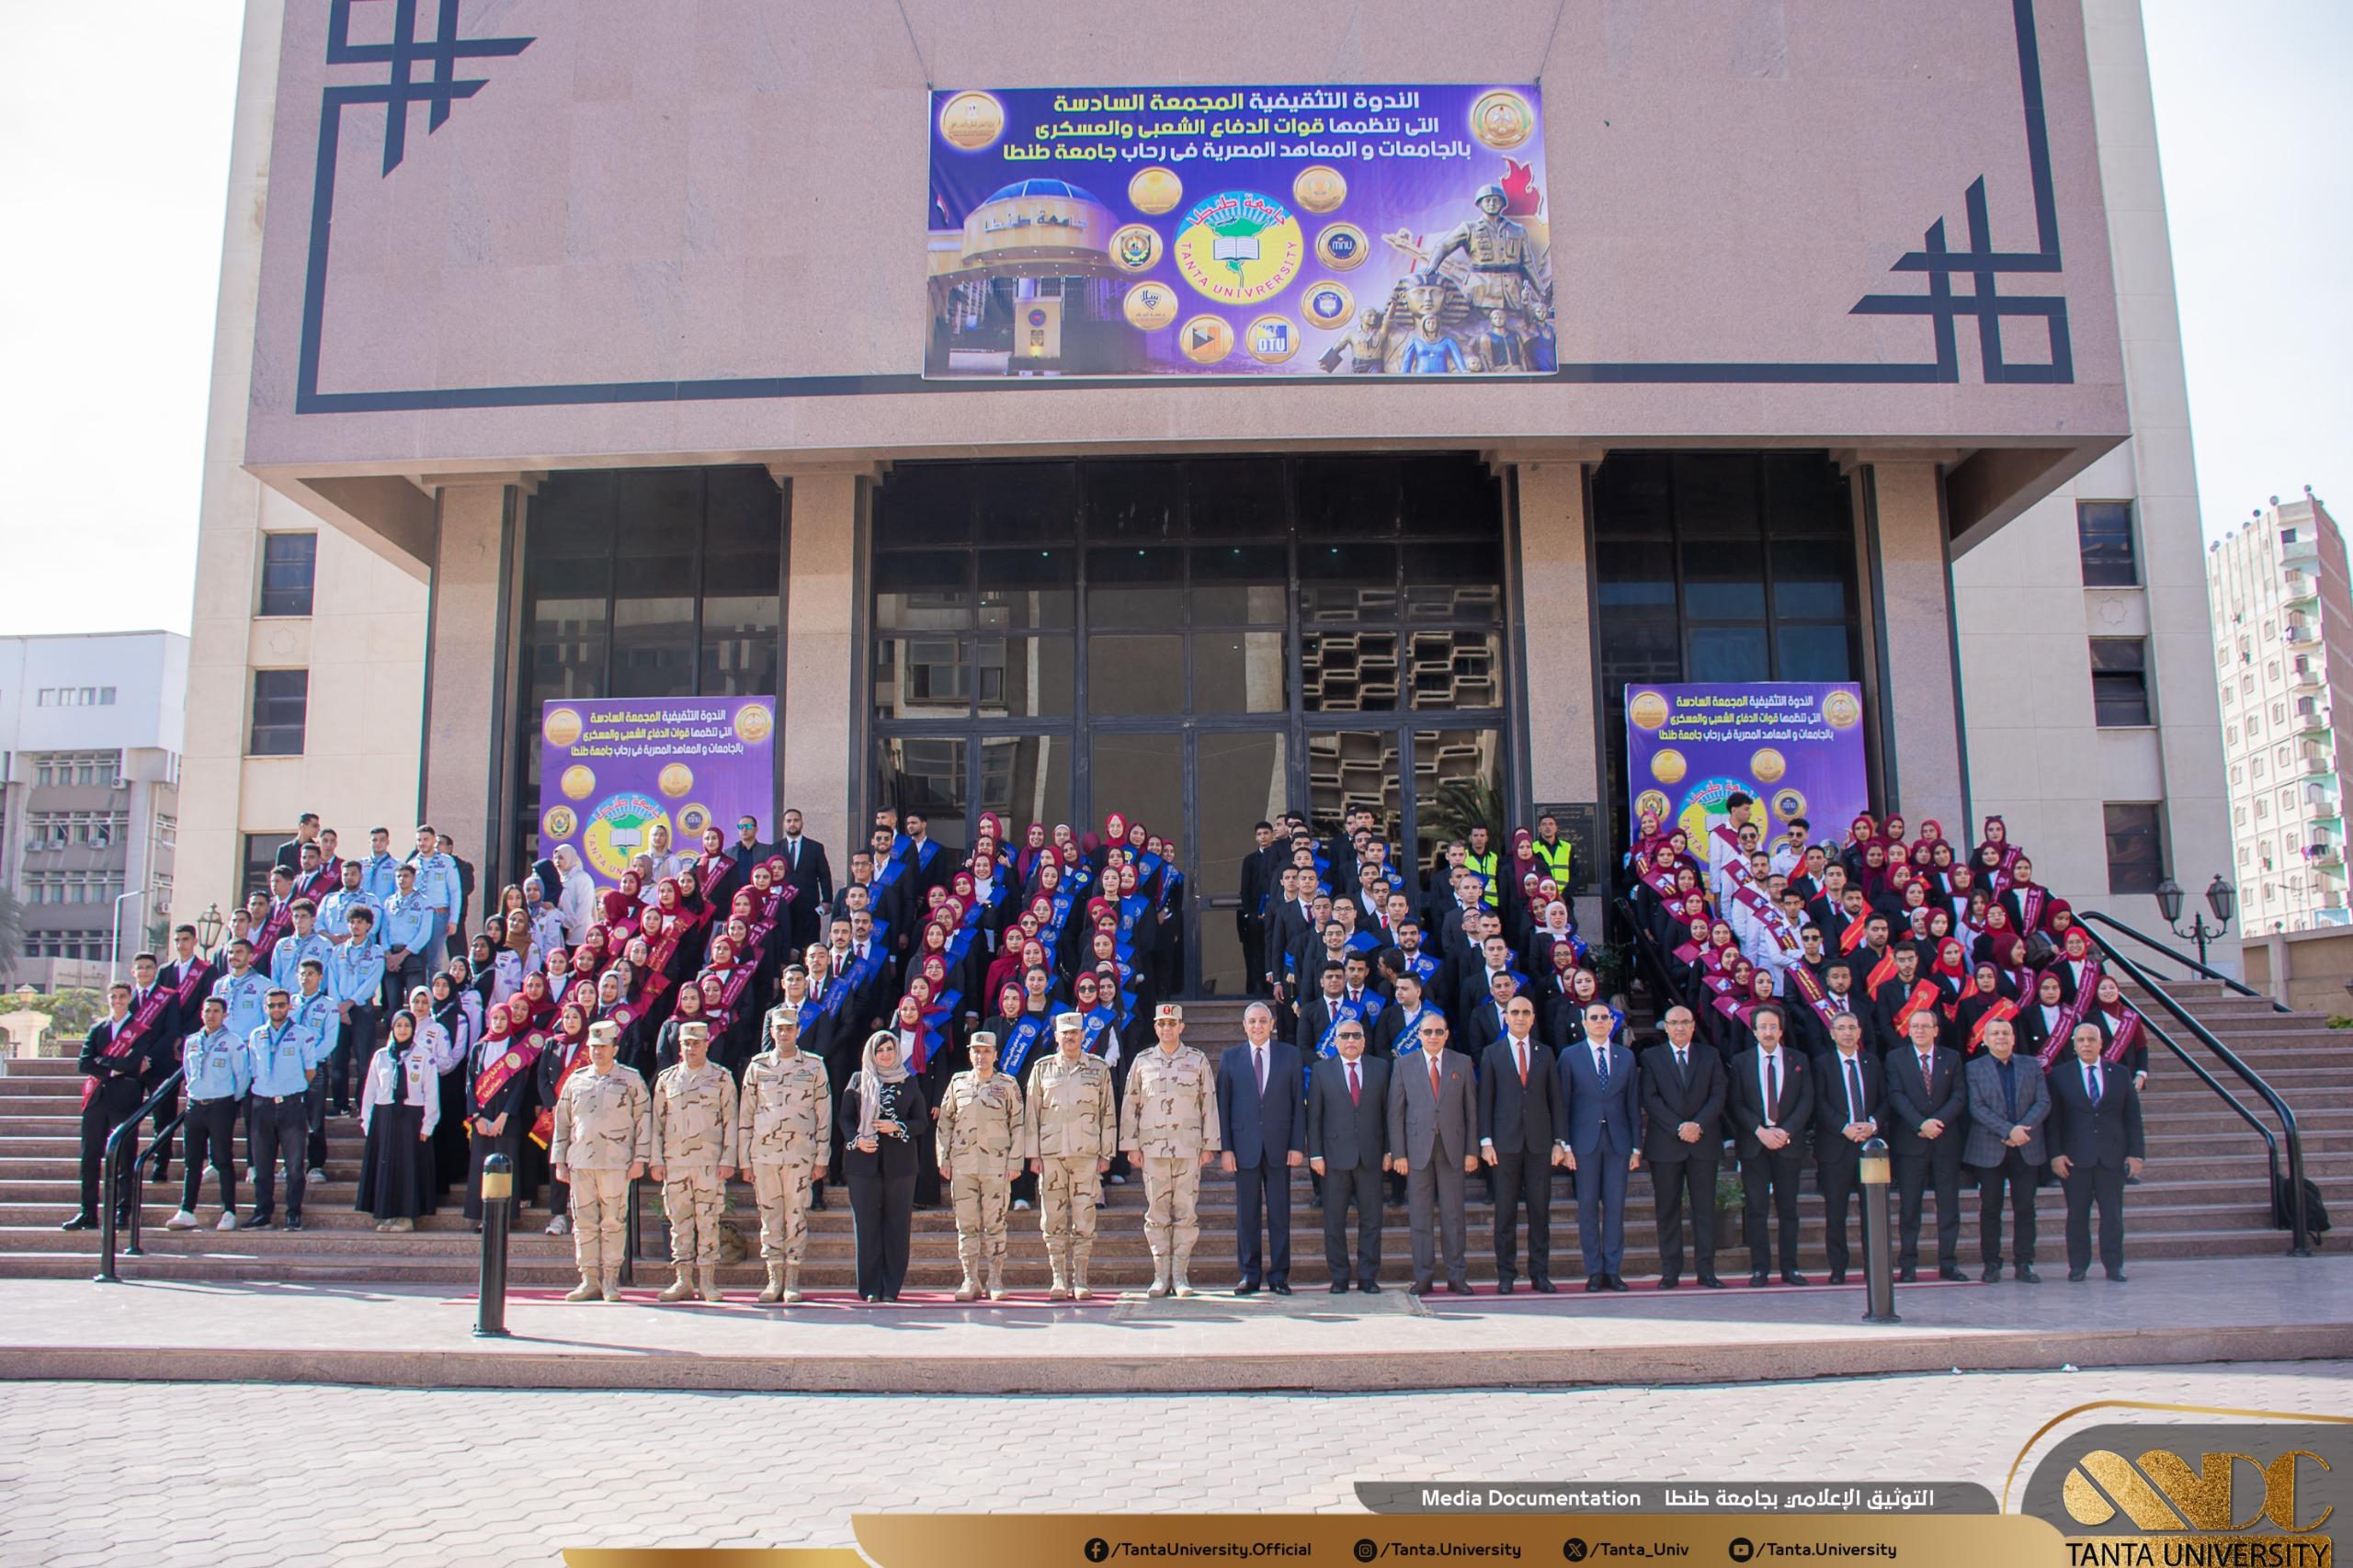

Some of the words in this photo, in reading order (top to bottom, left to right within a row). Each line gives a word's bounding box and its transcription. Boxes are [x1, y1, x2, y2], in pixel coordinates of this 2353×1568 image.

[1053, 95, 1144, 112] السادسة
[1150, 93, 1244, 114] المجمعة
[1249, 90, 1347, 113] التثقيفية
[1353, 92, 1419, 112] الندوة
[1211, 119, 1269, 138] الدفاع
[1274, 118, 1324, 137] قوات
[1329, 118, 1401, 133] تنظمها
[1003, 144, 1051, 160] طنطا
[1054, 143, 1117, 162] جامعة
[1121, 142, 1165, 162] رحاب
[1202, 141, 1276, 162] المصرية
[1280, 141, 1358, 157] المعاهد
[1361, 144, 1374, 160] و
[1379, 141, 1471, 160] بالجامعات
[1187, 194, 1237, 226] طنطا
[1244, 193, 1286, 225] جامعة
[1180, 242, 1210, 287] TANTA
[1213, 242, 1298, 298] UNIVRERSITY
[1257, 337, 1286, 352] DTU
